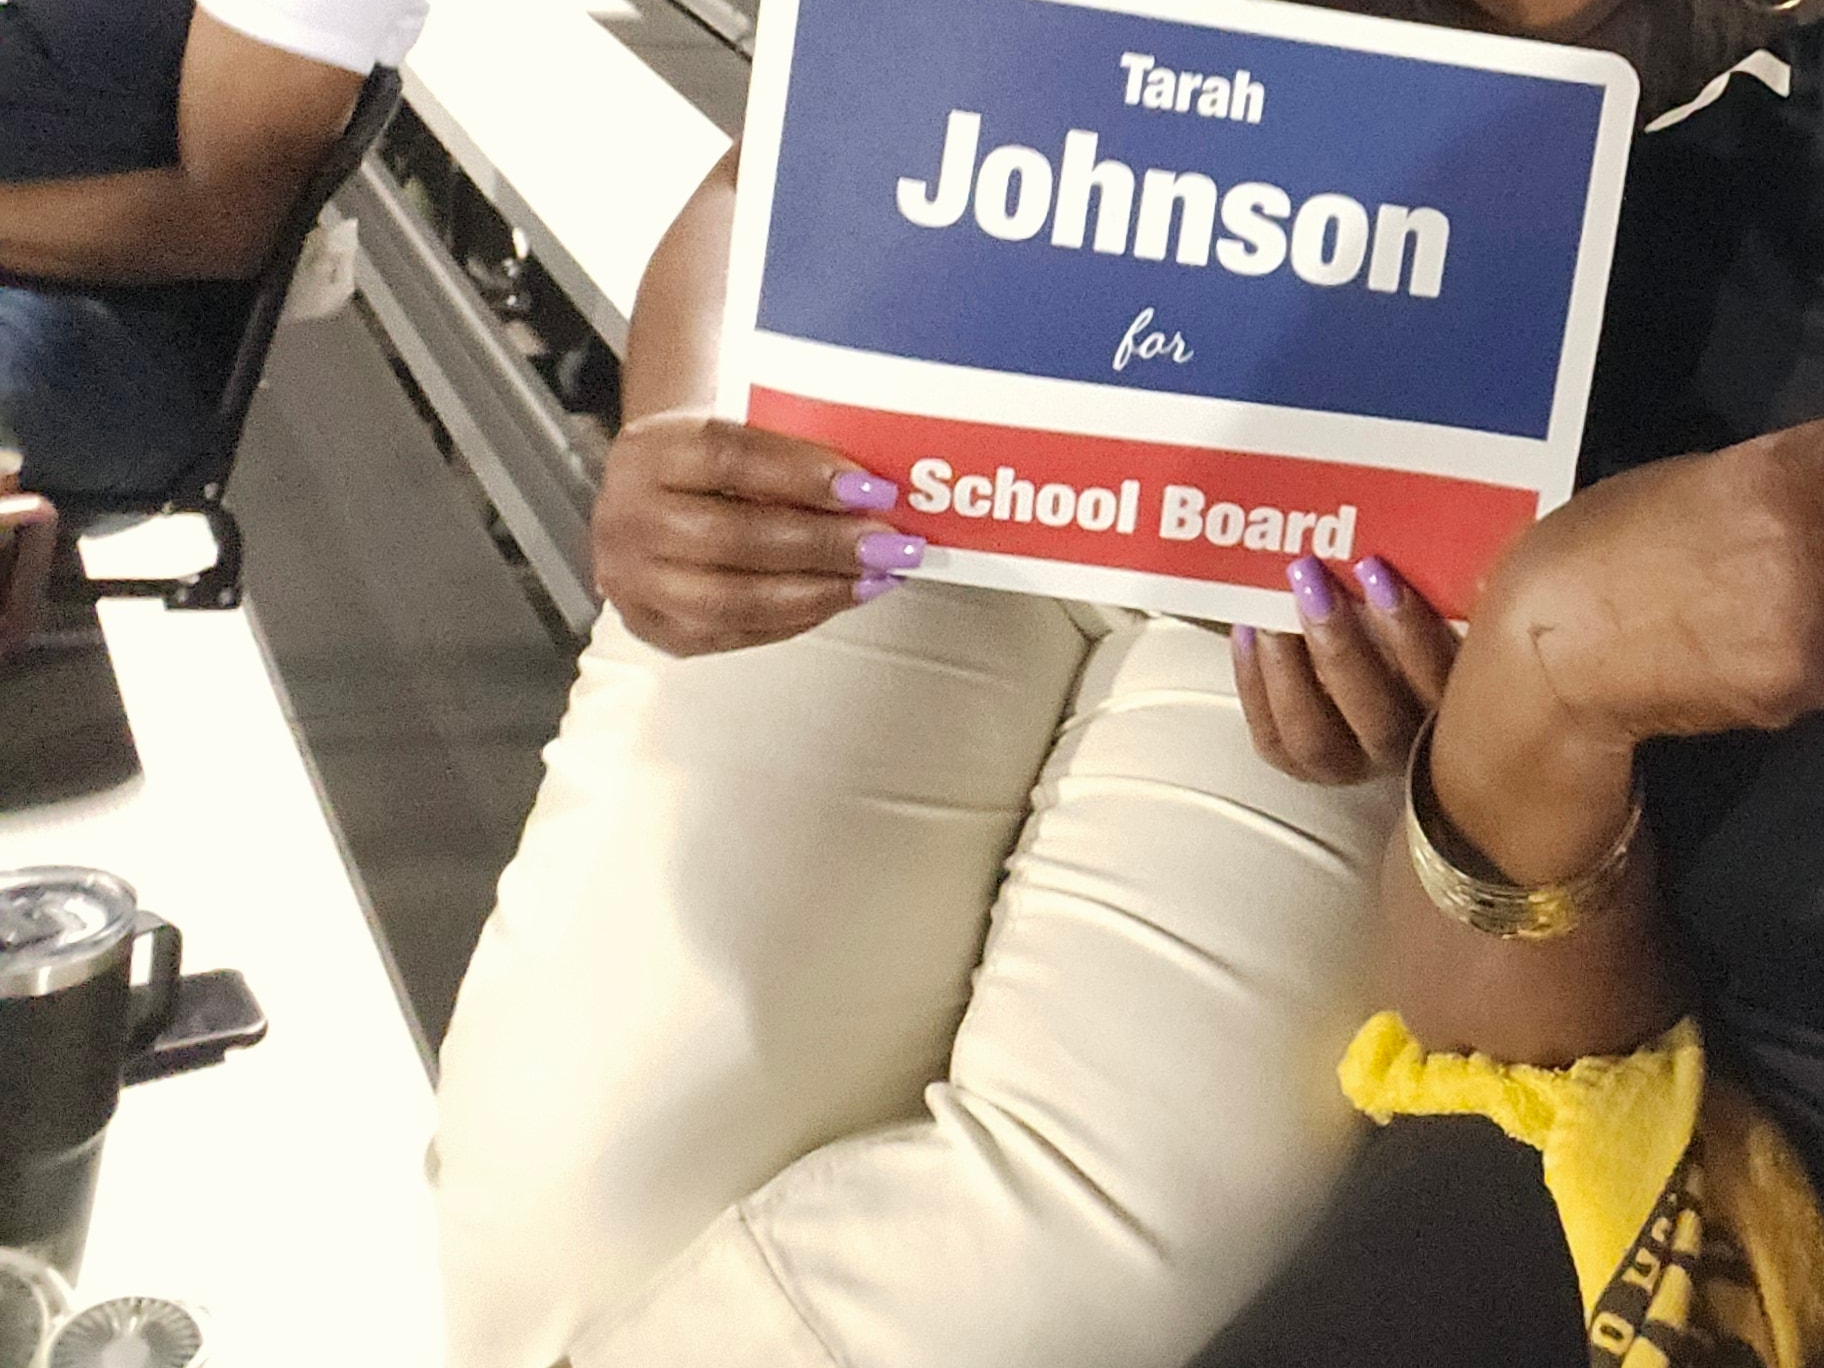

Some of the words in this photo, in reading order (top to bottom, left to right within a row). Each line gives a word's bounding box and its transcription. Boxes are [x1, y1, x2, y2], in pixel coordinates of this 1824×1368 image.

[1120, 51, 1265, 124] Tarah
[895, 108, 1450, 298] Johnson
[1112, 307, 1194, 371] for
[908, 458, 1141, 535] School
[1158, 484, 1358, 562] Board
